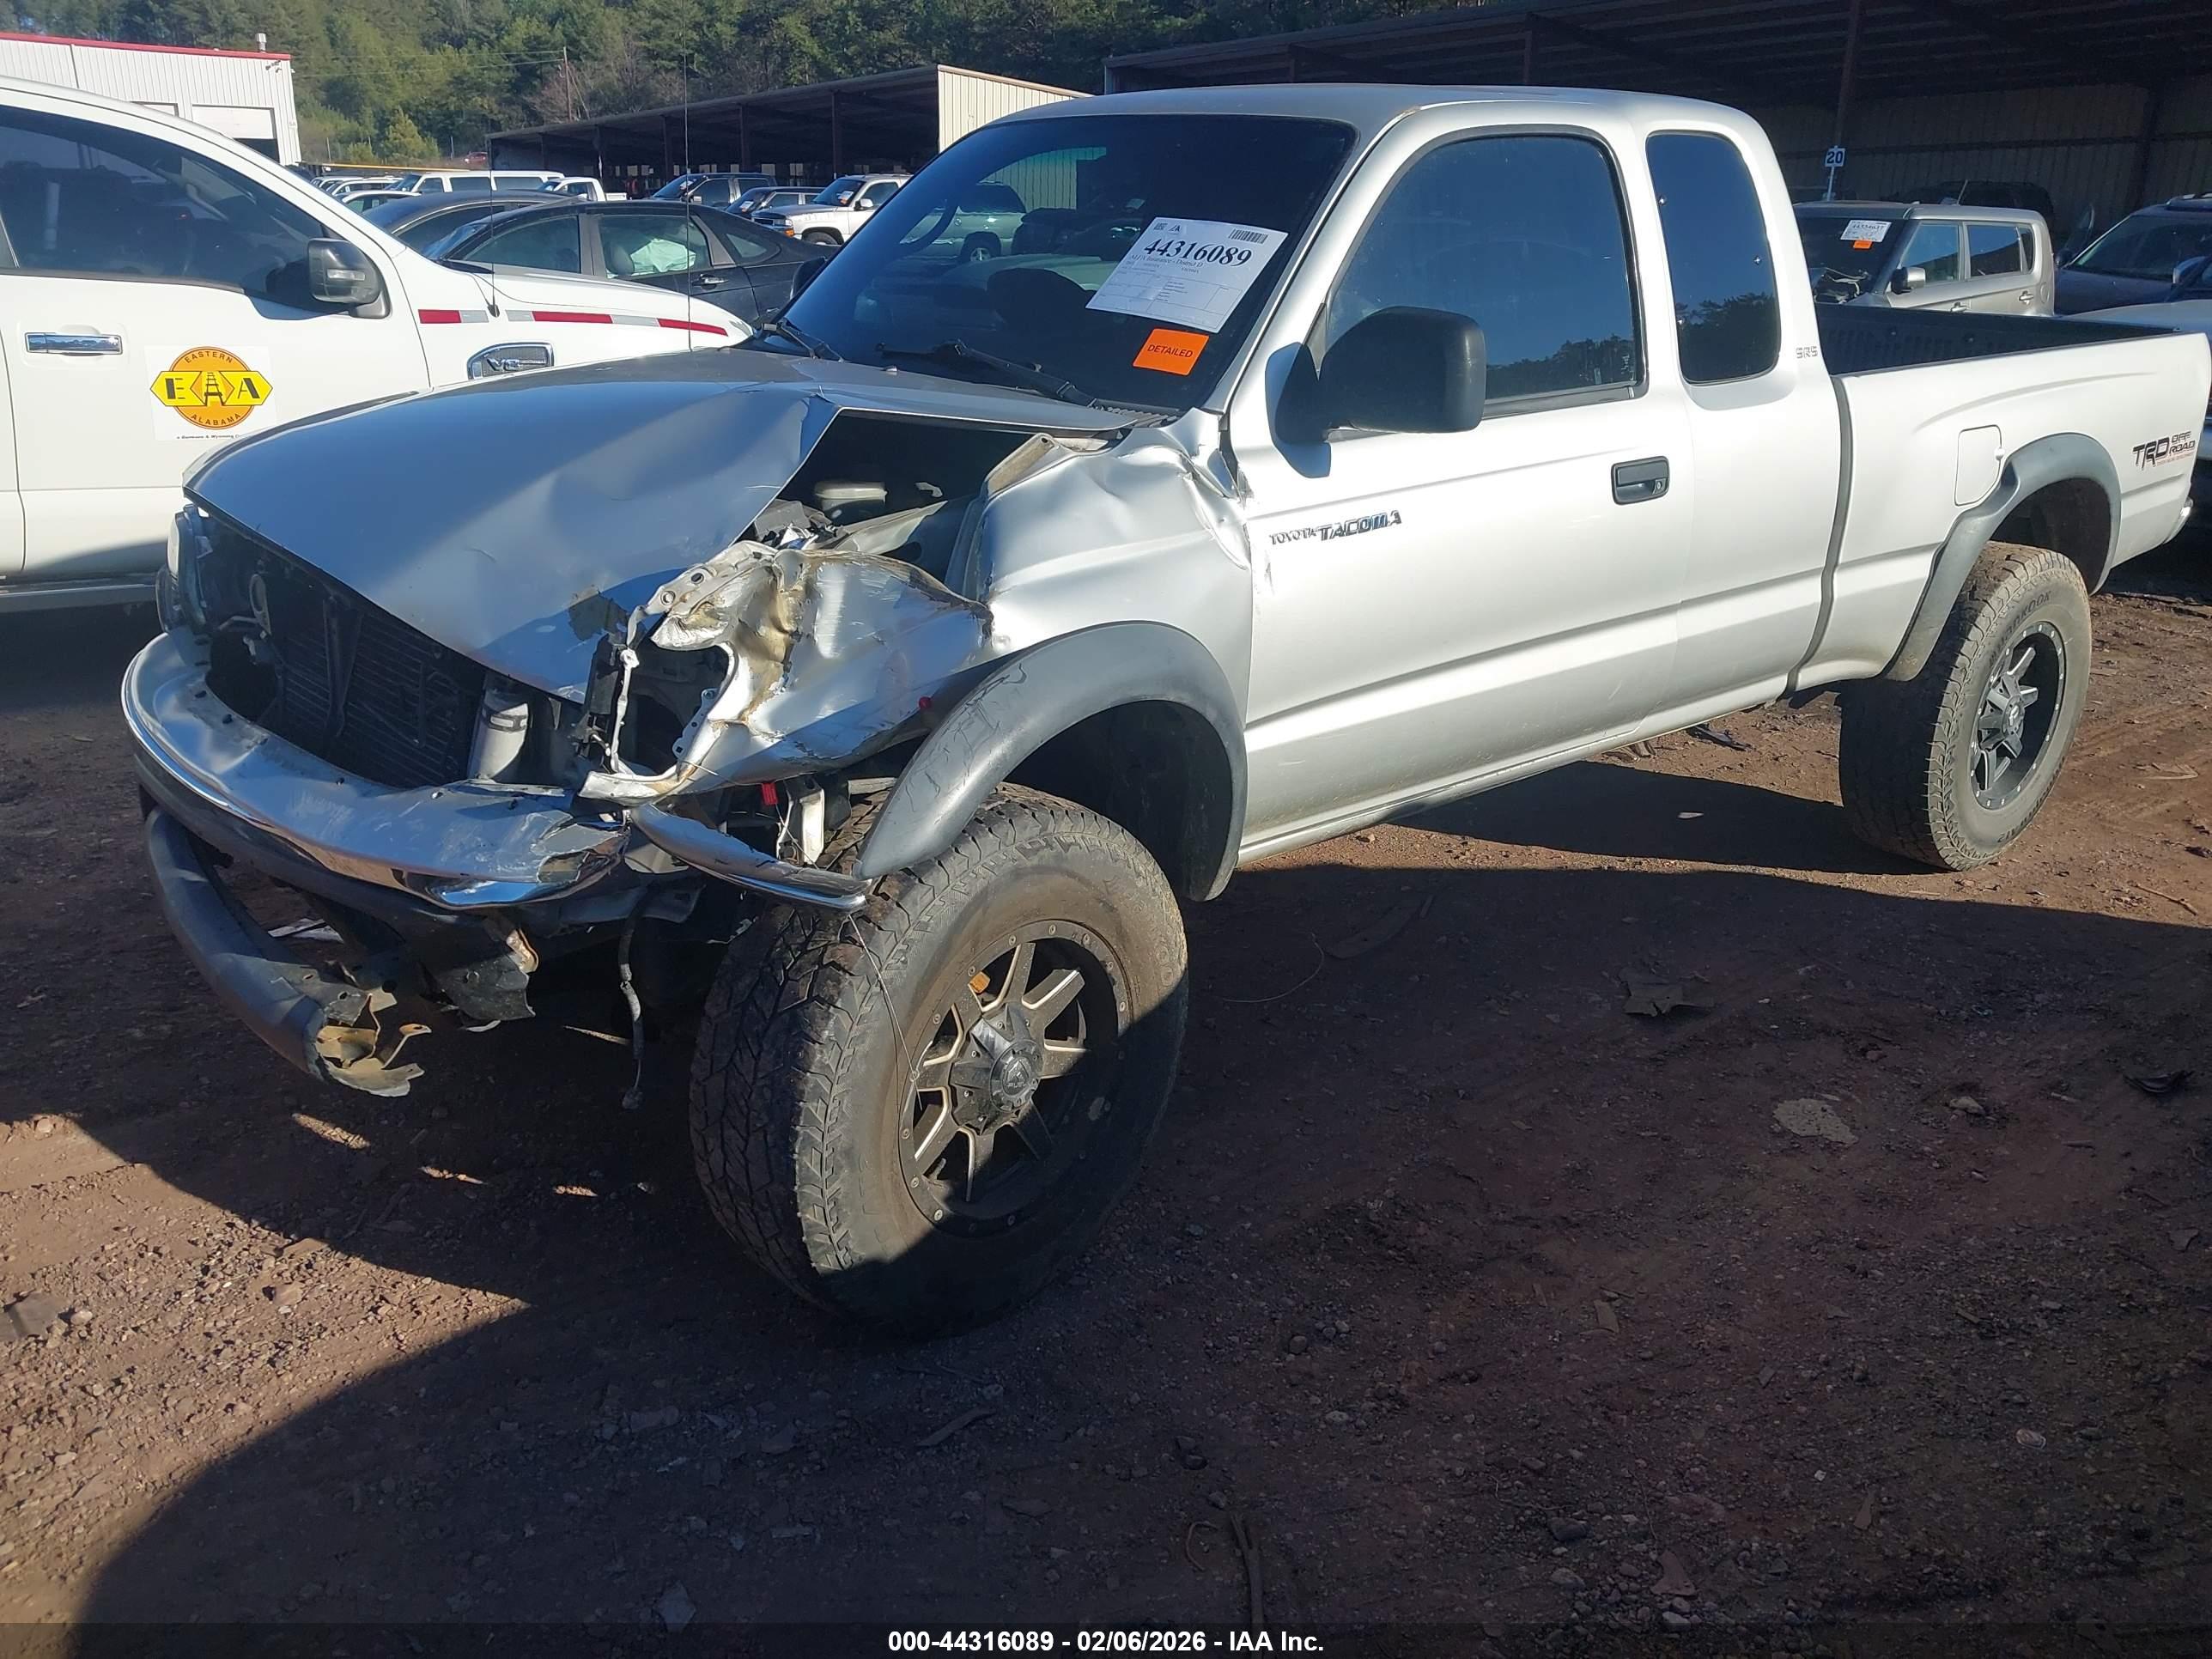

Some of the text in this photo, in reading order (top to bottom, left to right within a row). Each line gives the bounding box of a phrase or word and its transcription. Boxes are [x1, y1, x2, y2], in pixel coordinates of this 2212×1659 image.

[1826, 151, 1844, 164] 20
[1144, 239, 1252, 266] 44316089
[185, 350, 234, 363] EASTERN
[1147, 344, 1194, 358] DETAILED
[1796, 345, 1818, 359] SRS
[191, 413, 241, 426] ALABAMA
[2133, 437, 2170, 471] TRD
[2172, 431, 2191, 443] OFF
[2169, 441, 2196, 455] ROAD
[1269, 510, 1402, 545] TOYOTA TACOMA
